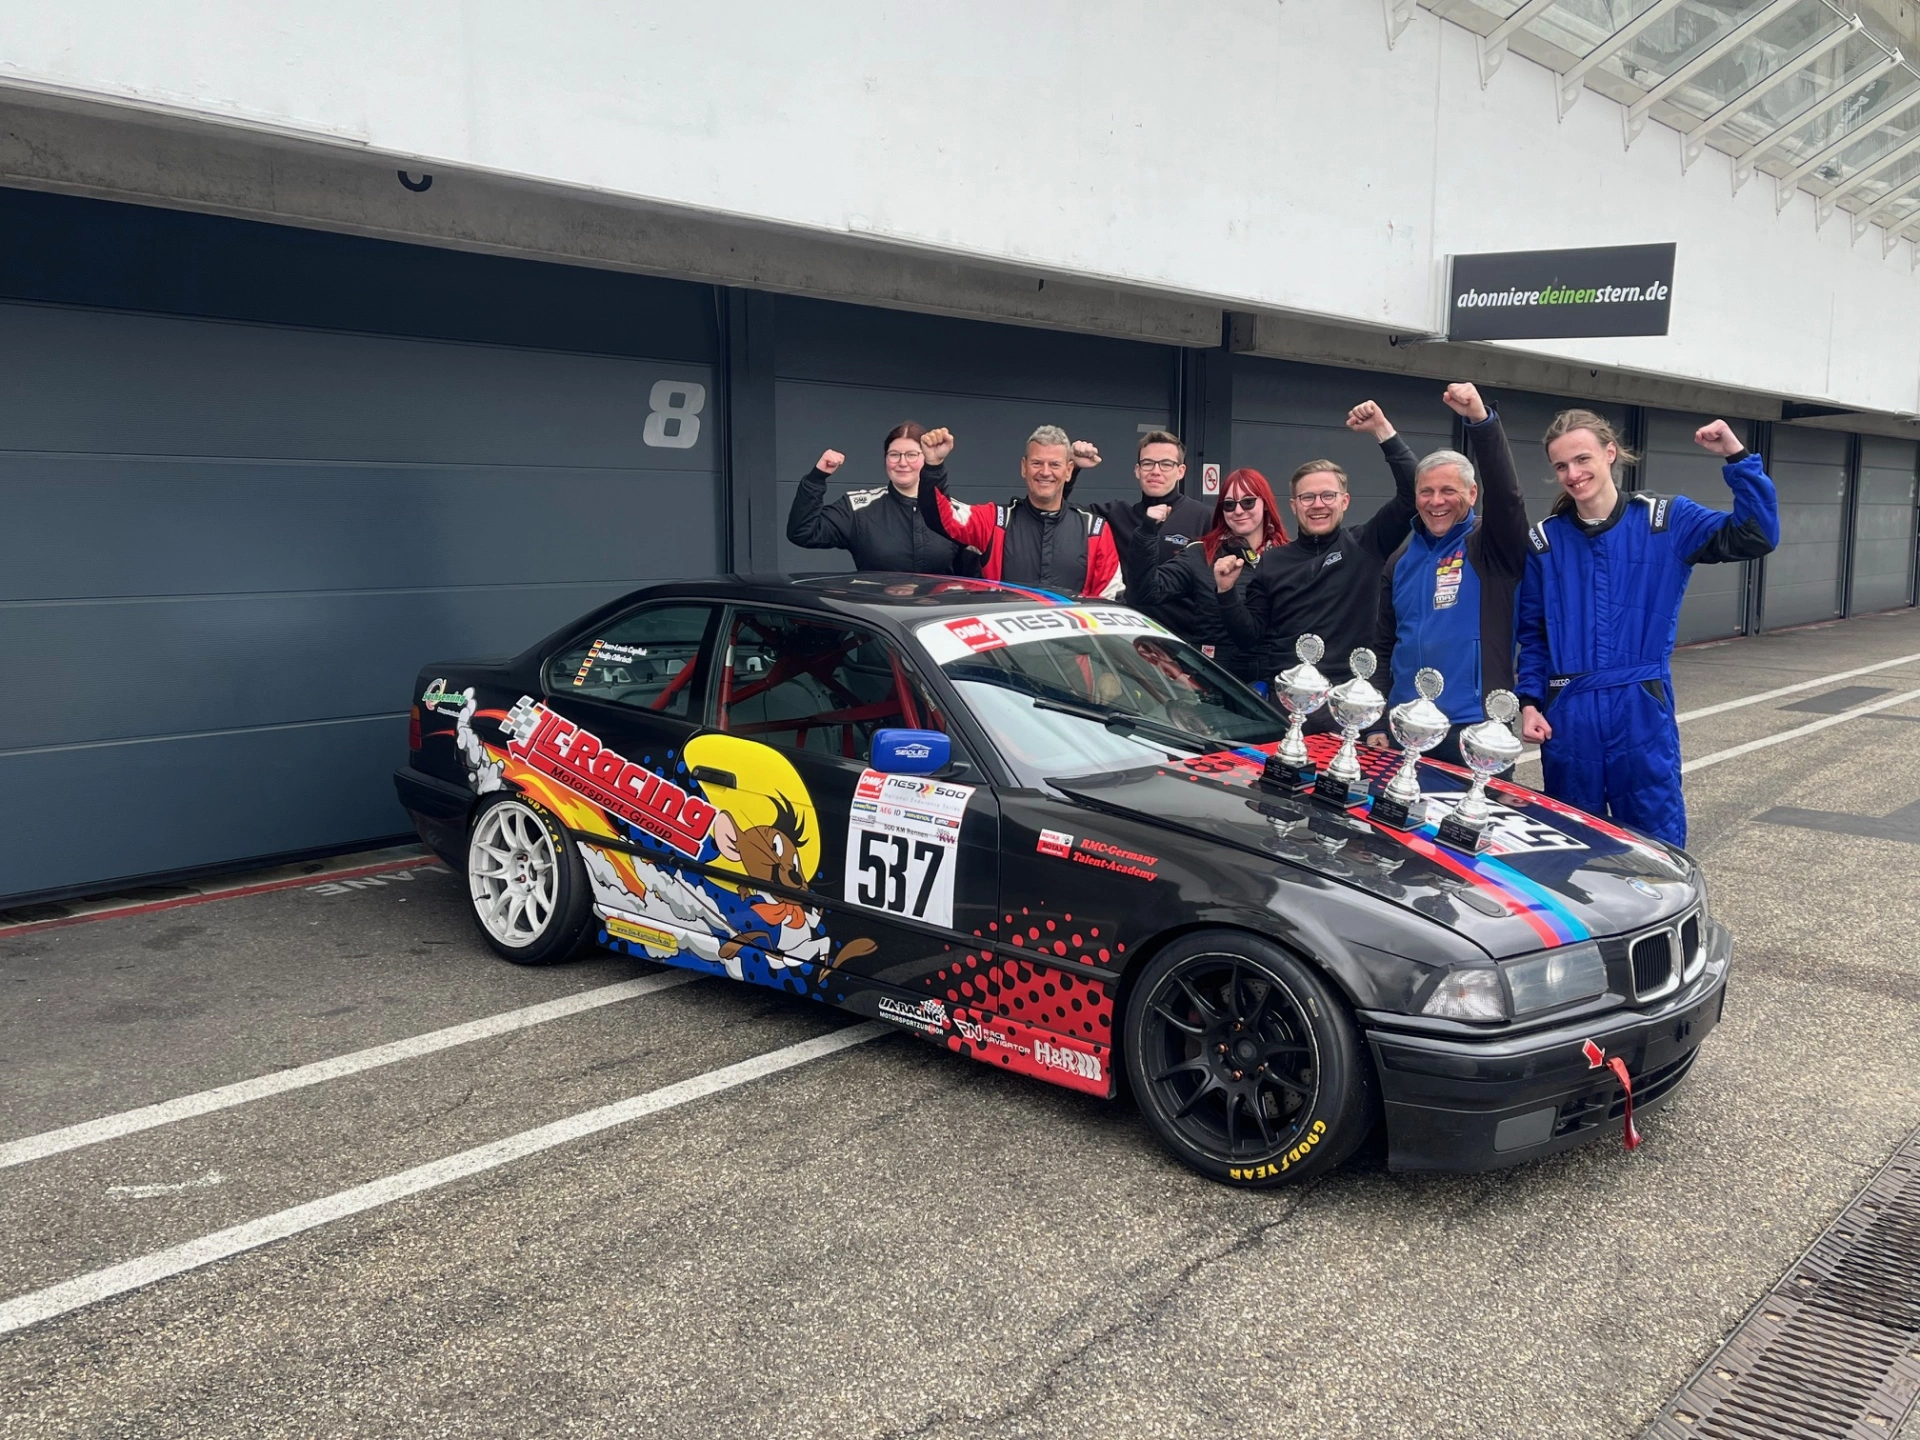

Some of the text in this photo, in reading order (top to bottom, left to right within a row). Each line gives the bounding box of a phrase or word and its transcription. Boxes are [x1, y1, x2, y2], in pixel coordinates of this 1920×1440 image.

[1457, 280, 1668, 308] abonnieredeinenstern.de
[643, 380, 706, 449] 8
[1655, 499, 1667, 527] sparco
[1099, 611, 1150, 628] 500
[954, 622, 985, 640] DMV
[861, 775, 885, 787] DMV
[934, 787, 967, 800] 500
[550, 766, 673, 841] Motorsport-Group
[880, 806, 892, 815] AEG
[884, 823, 928, 838] 500 KM Rennen
[1042, 842, 1063, 853] ROTAX
[1080, 838, 1158, 866] RMC-Germany
[858, 829, 945, 918] 537
[1073, 851, 1158, 882] Talent-Academy
[984, 1029, 1005, 1040] RACE
[984, 1036, 1031, 1054] NAVIGATOR
[1229, 1120, 1326, 1180] GOODYEAR
